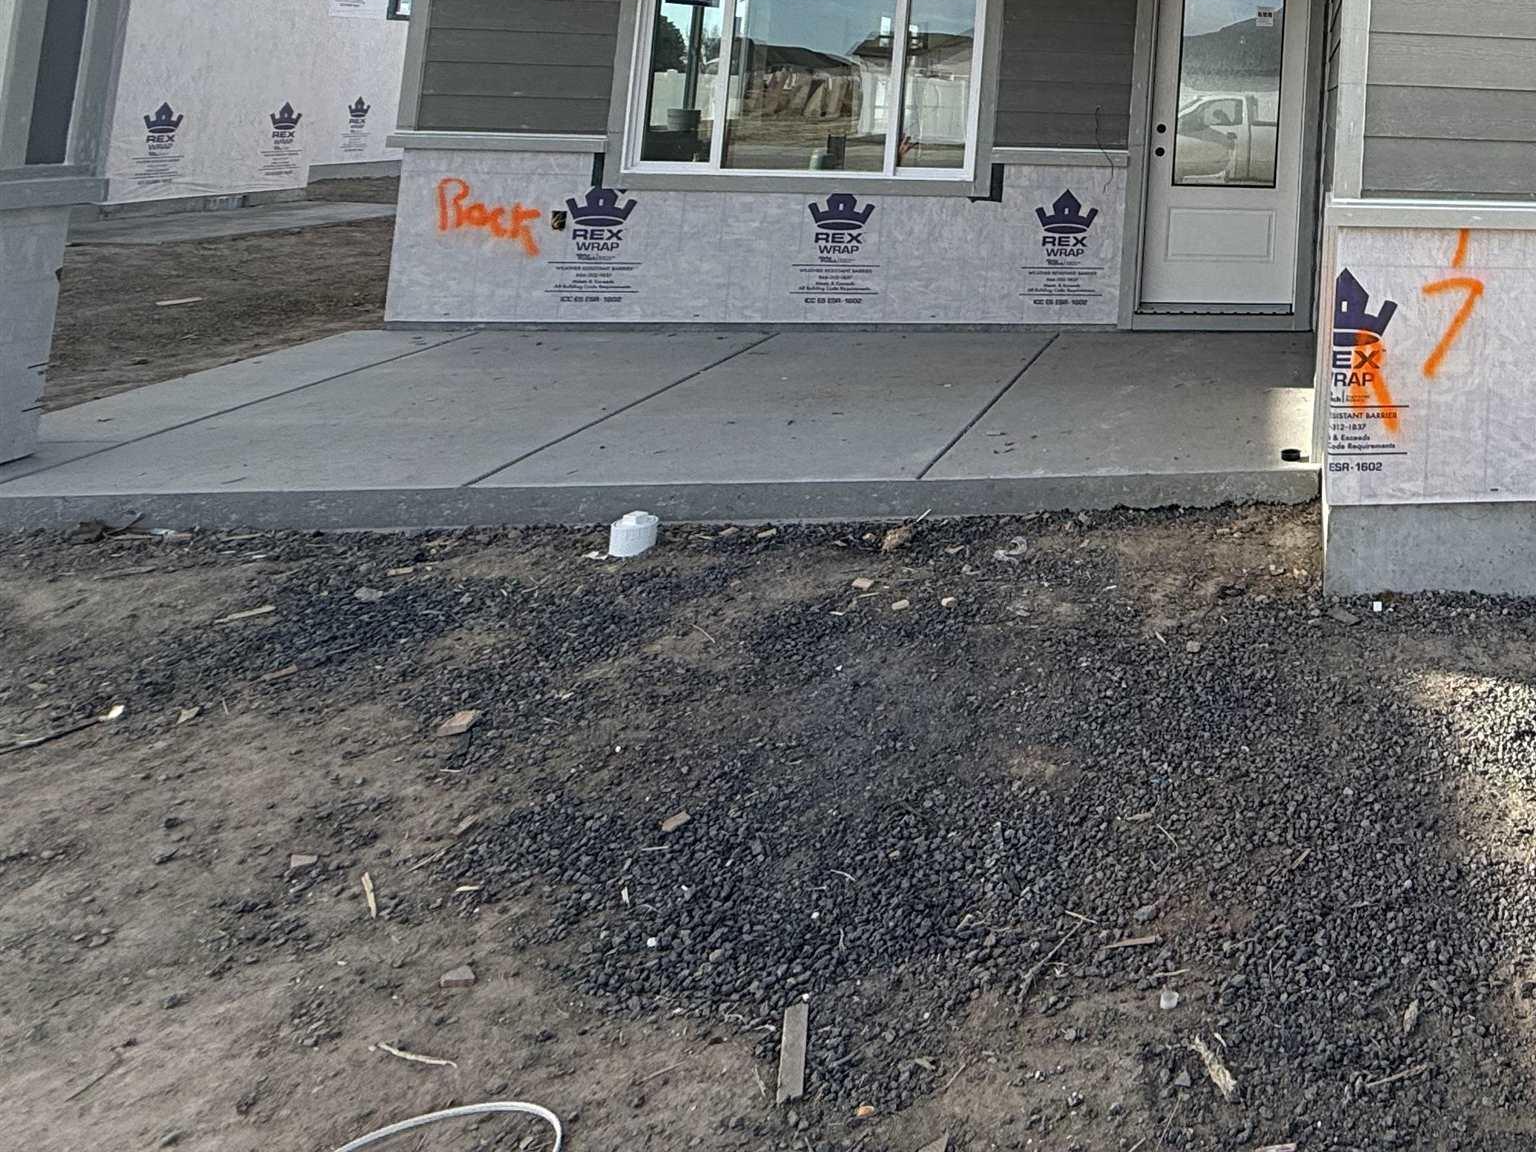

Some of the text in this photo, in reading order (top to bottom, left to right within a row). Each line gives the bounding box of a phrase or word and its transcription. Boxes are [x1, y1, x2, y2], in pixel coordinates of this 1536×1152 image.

[146, 134, 175, 143] REX
[572, 229, 623, 240] REX
[814, 232, 863, 244] REX
[1041, 236, 1088, 247] REX
[576, 242, 620, 251] WRAP
[818, 245, 859, 254] WRAP
[1046, 248, 1085, 257] WRAP
[1332, 351, 1380, 369] EX
[1332, 372, 1375, 386] RAP
[1341, 433, 1370, 441] Exceeds
[1347, 442, 1396, 450] Requirements
